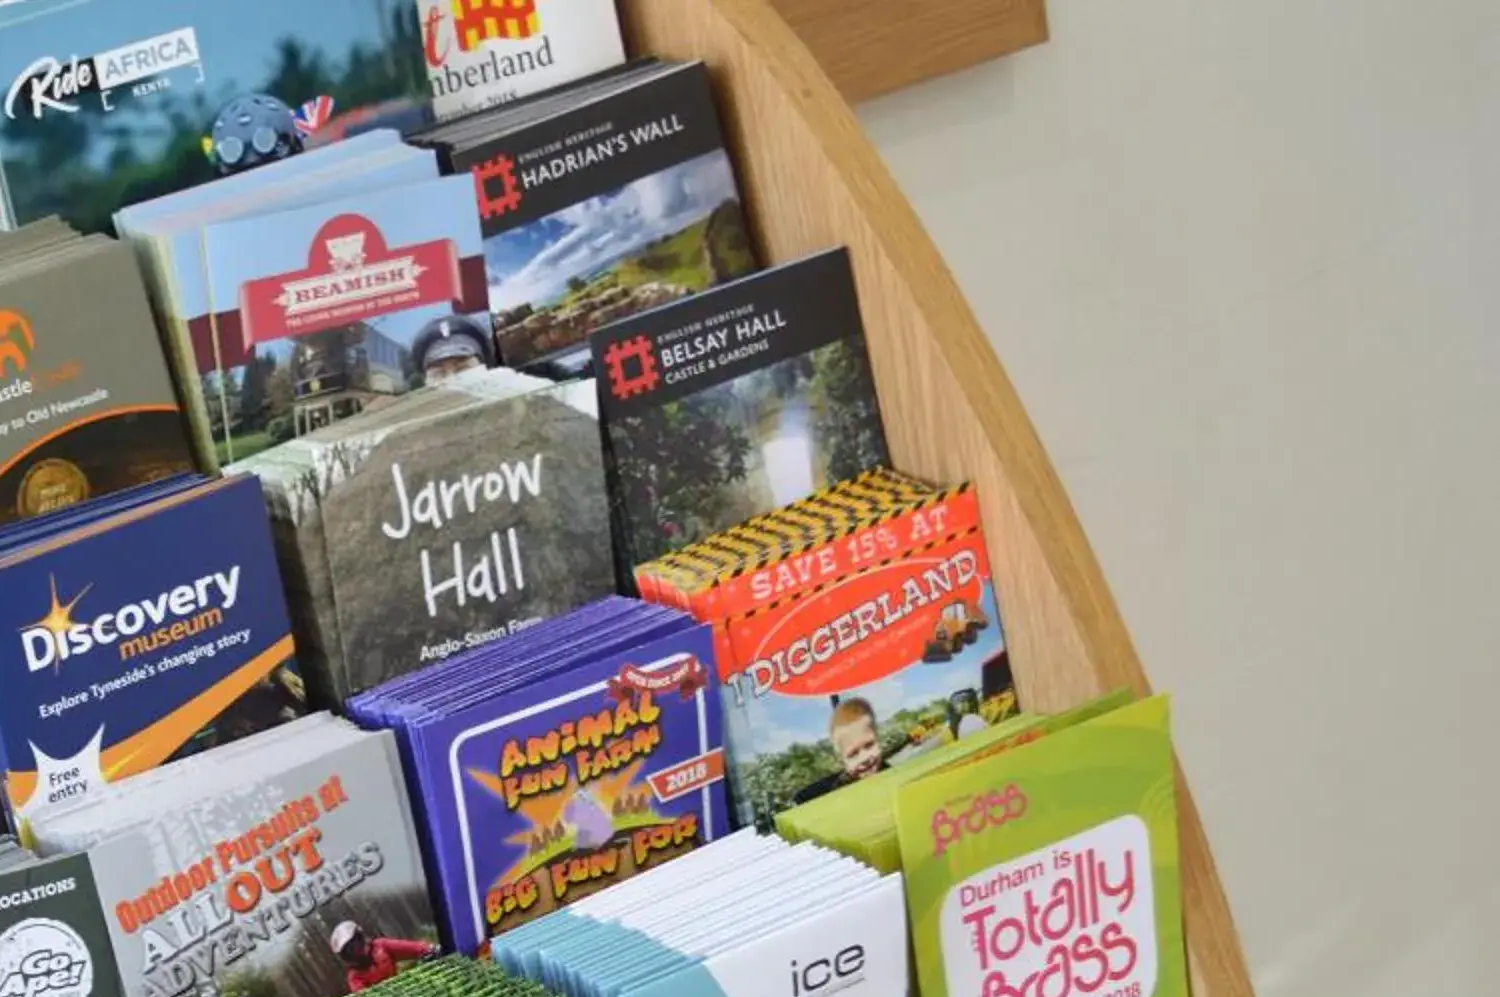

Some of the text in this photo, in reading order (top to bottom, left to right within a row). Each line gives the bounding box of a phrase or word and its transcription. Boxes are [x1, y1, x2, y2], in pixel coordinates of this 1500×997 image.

[4, 36, 192, 119] Ride AFRICA
[429, 35, 555, 97] mberland
[520, 113, 685, 189] HADRIAN'S WALL
[294, 267, 406, 304] BEAMISH
[660, 309, 787, 368] BELSAY HALL
[663, 338, 770, 385] CASTLE & GARDENS
[11, 417, 26, 431] to
[26, 408, 50, 424] Old
[50, 387, 109, 417] Newcastle
[381, 452, 543, 540] Jarrow
[420, 526, 525, 618] Hall
[749, 505, 949, 602] SAVE 15% AT
[21, 565, 241, 672] Discovery
[117, 607, 224, 662] museum
[419, 624, 507, 661] Anglo-Saxon
[745, 548, 978, 699] DIGGERLAND
[38, 628, 251, 720] Explore Tyneside's changing story
[48, 780, 88, 804] entry
[49, 766, 81, 788] Free
[501, 723, 664, 811] FUN FARM
[114, 773, 350, 936] Outdoor Pursuits at
[551, 848, 622, 900] FUN
[629, 813, 699, 868] FOR
[958, 849, 1073, 908] Durham is
[140, 827, 324, 976] ALL OUT
[961, 847, 1135, 970] Totally
[19, 948, 74, 976] Go
